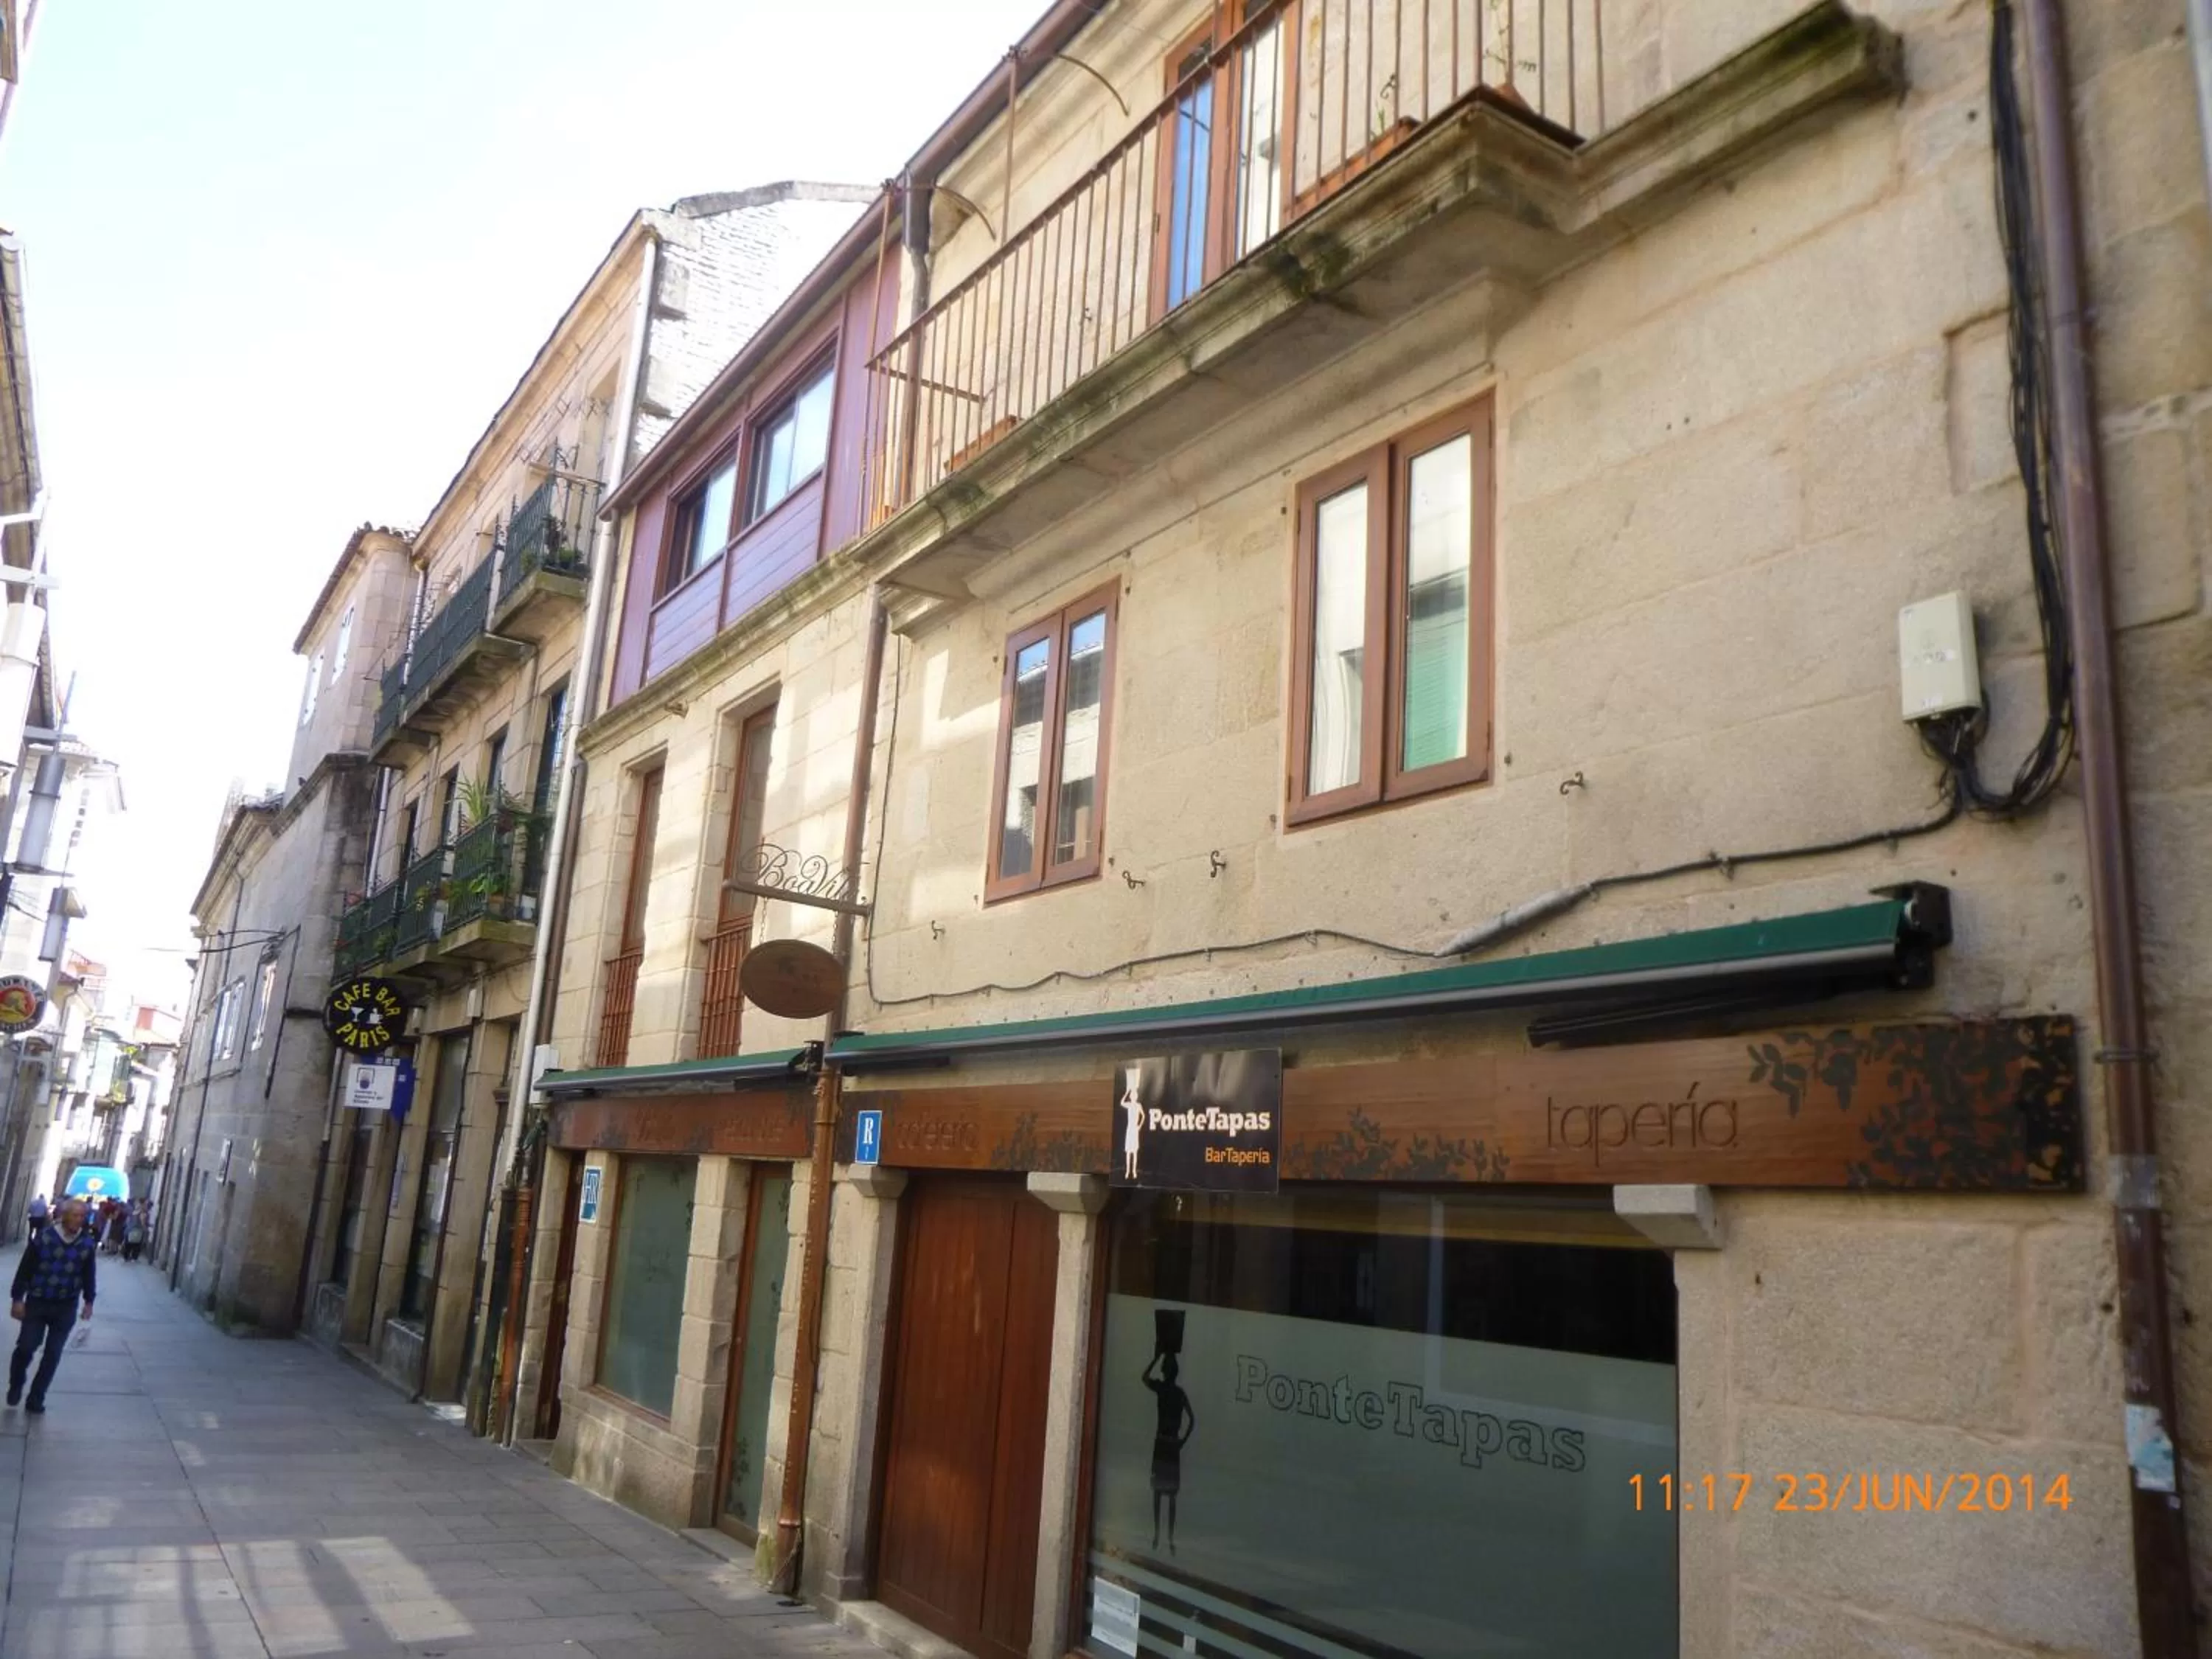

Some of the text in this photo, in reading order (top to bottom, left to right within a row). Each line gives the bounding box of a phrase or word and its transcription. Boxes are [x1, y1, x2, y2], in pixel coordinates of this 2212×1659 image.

[334, 983, 401, 1016] CAFE BAR
[336, 1022, 390, 1048] PARIS
[863, 1116, 874, 1144] R
[1149, 1107, 1271, 1137] PonteTapas
[1547, 1080, 1738, 1169] tapería
[1234, 1354, 1586, 1473] PonteTapas
